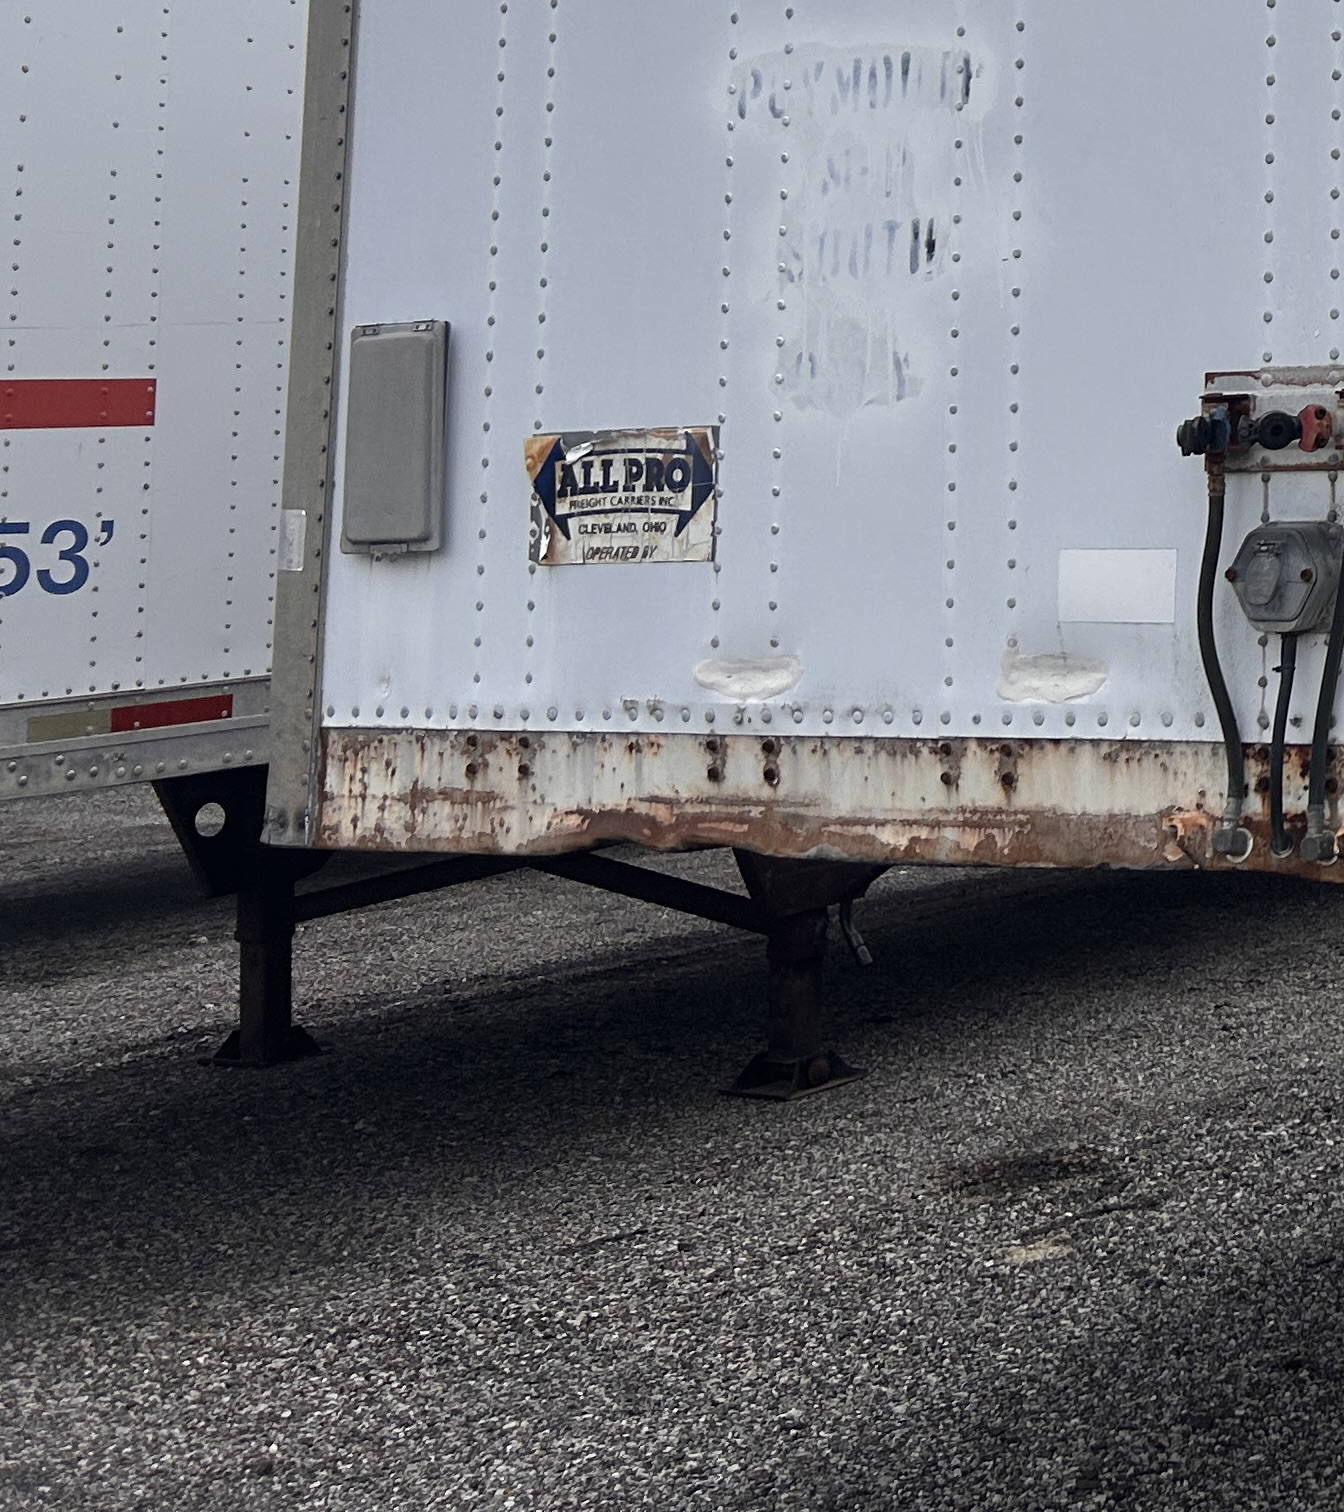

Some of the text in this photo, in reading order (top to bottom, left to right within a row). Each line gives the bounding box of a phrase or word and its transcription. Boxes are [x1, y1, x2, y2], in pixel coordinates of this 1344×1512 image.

[557, 457, 692, 498] ALL PRO
[568, 496, 608, 511] FREIGHT
[610, 494, 657, 507] CARRIERS
[578, 521, 667, 535] CLEVELAND, OHIO
[586, 545, 658, 561] OPERATED BY
